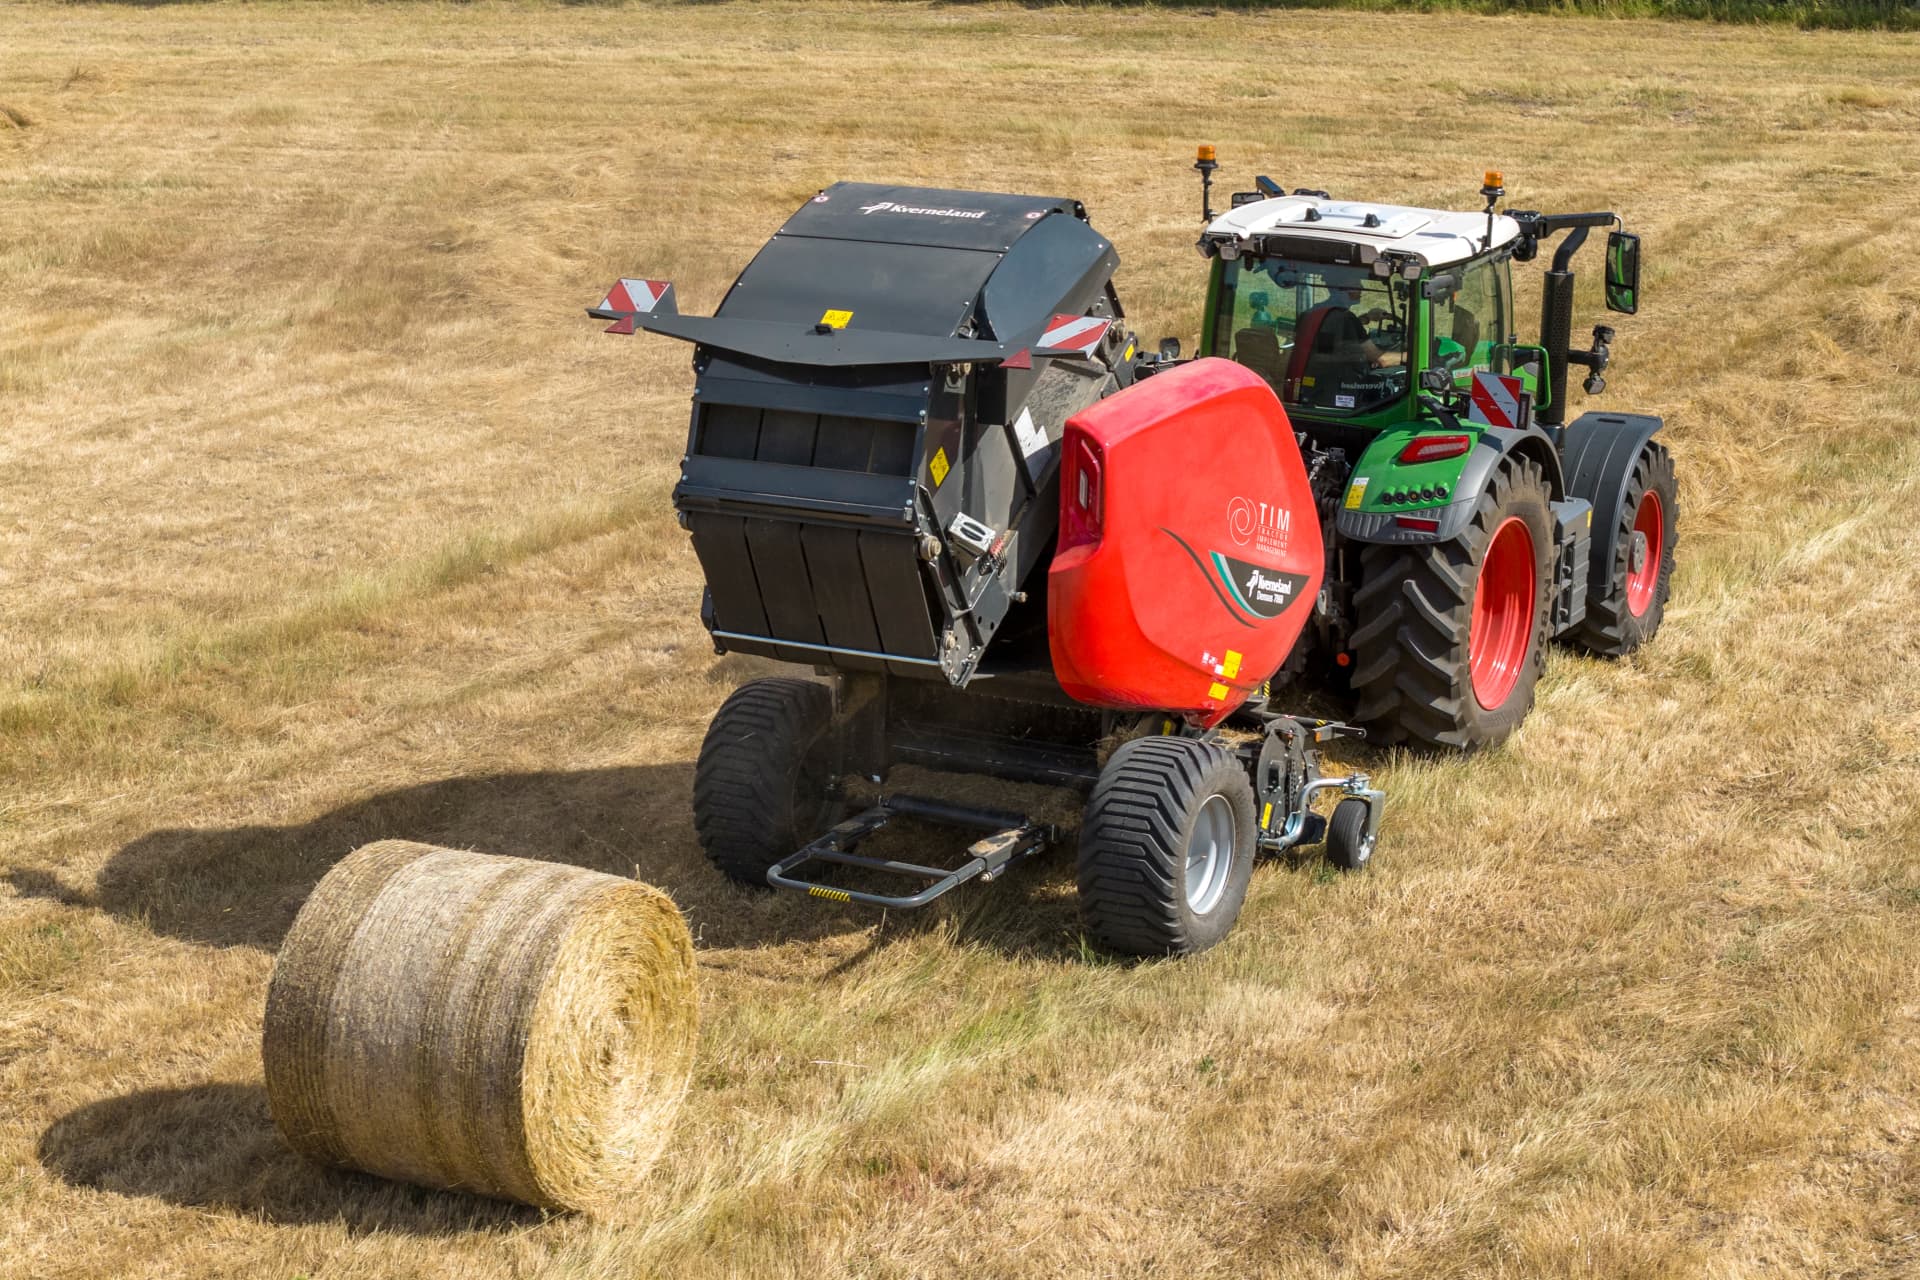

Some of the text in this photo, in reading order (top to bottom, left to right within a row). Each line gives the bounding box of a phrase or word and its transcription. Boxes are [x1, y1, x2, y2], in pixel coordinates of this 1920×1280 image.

[889, 204, 986, 219] Kverneland
[1259, 502, 1290, 532] TIM
[1256, 535, 1288, 549] IMPLEMENT
[1257, 574, 1292, 595] Kverneland
